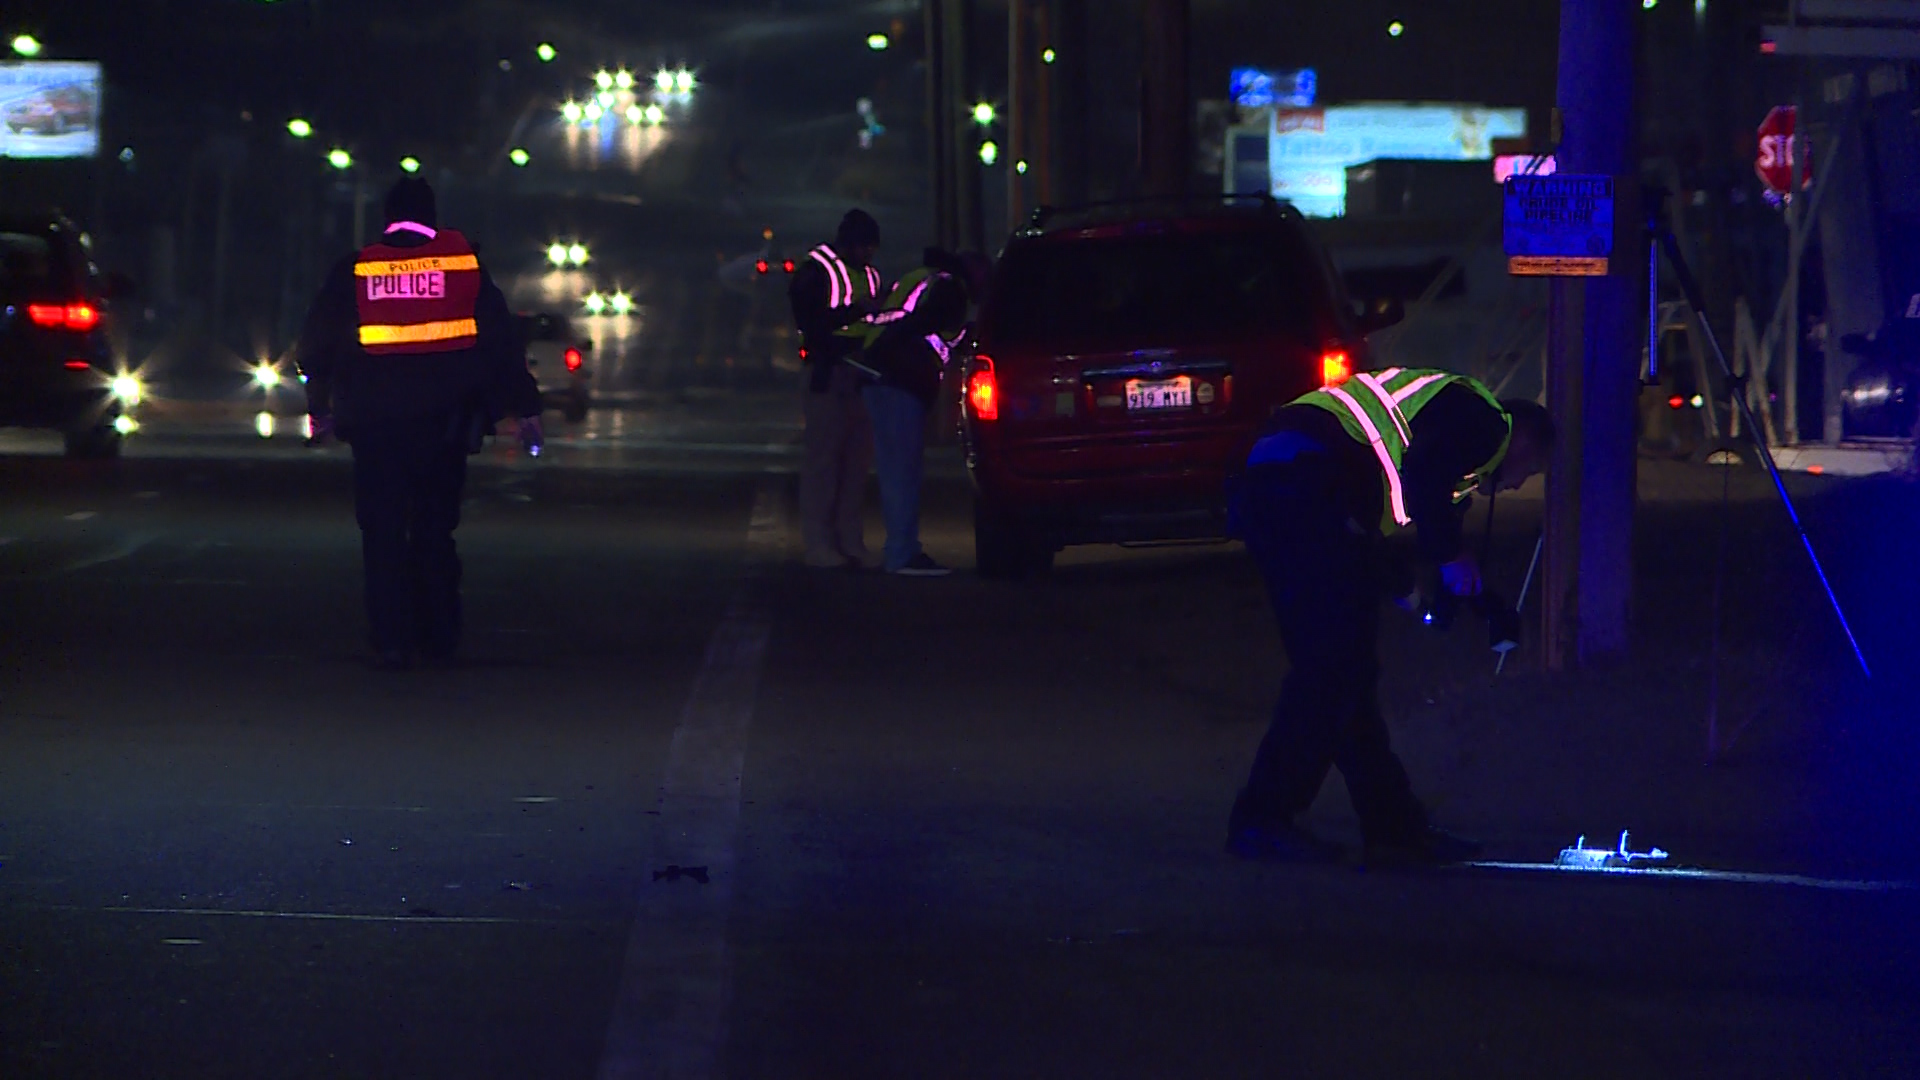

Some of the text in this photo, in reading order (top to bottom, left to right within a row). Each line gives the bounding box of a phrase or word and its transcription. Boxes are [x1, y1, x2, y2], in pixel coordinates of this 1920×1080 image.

[1759, 134, 1808, 169] STO
[1514, 181, 1605, 196] WARNING
[389, 259, 441, 272] POLICE
[372, 272, 440, 297] POLICE
